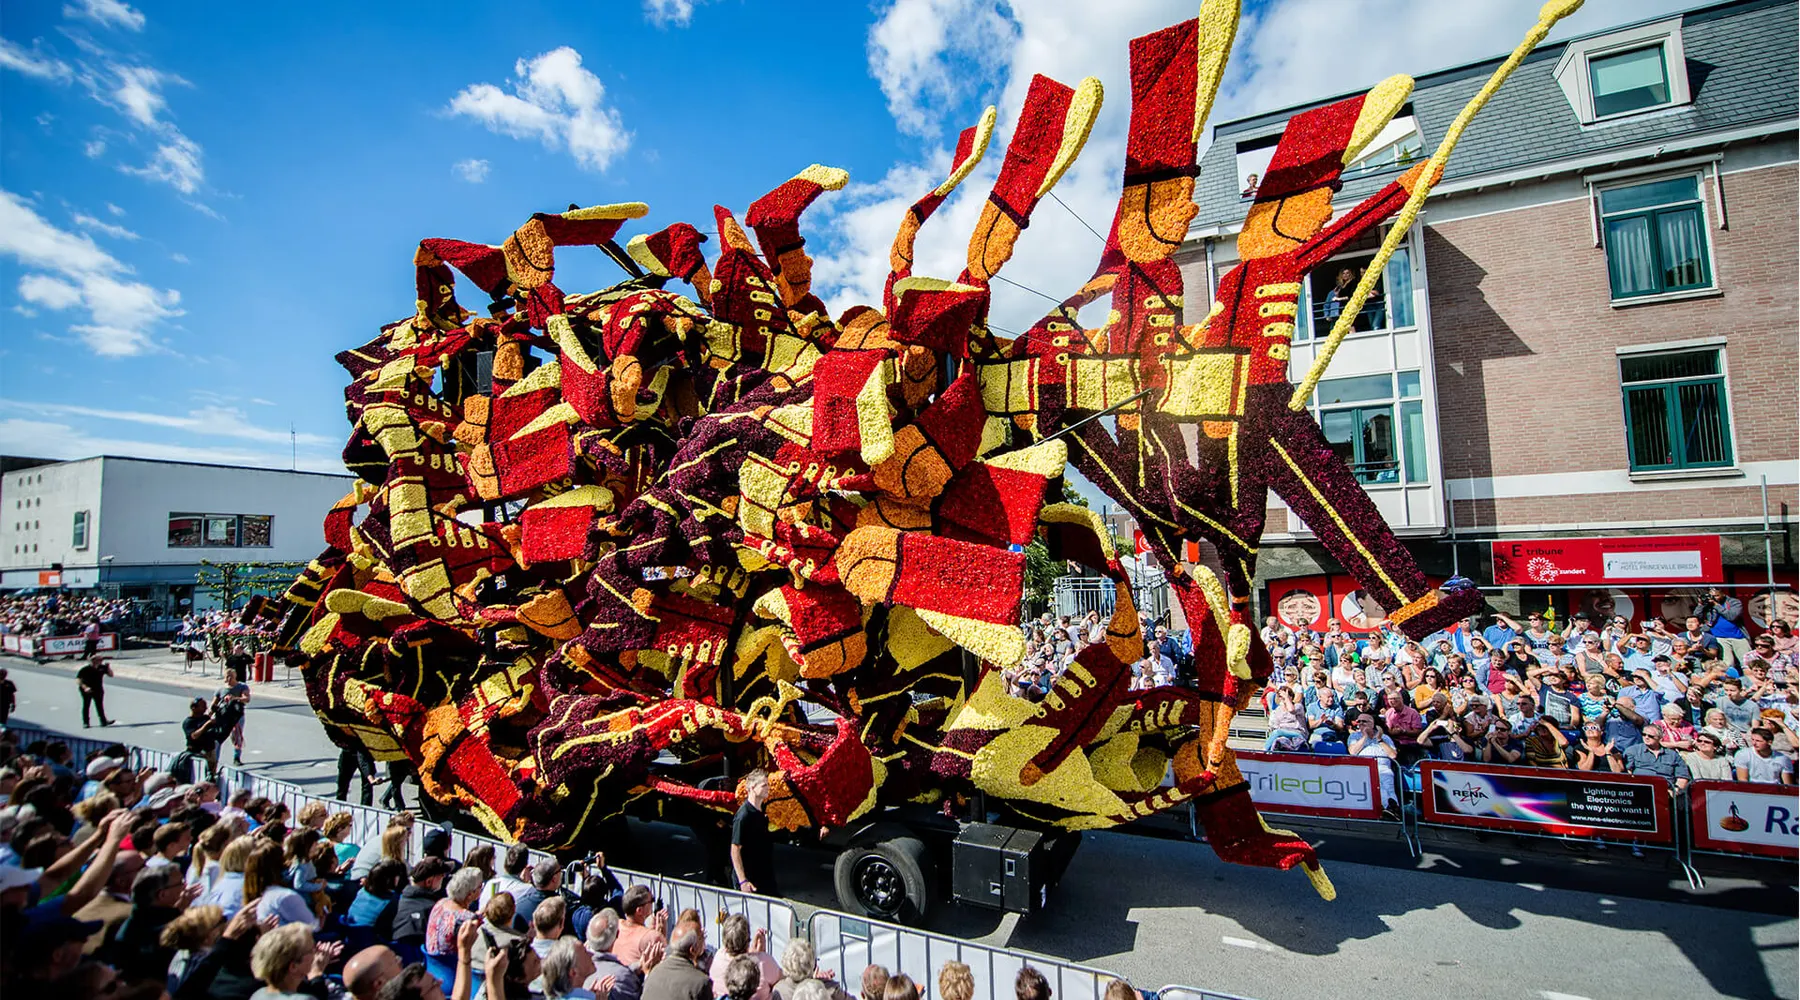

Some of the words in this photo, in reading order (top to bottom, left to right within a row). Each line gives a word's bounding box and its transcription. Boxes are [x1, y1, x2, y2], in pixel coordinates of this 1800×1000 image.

[1512, 544, 1522, 557] E
[1241, 770, 1368, 802] Triledgy
[1453, 790, 1489, 799] RENA
[1583, 787, 1616, 797] Lighting
[1587, 795, 1632, 805] Electronics
[1571, 802, 1584, 810] the
[1586, 805, 1602, 813] way
[1644, 807, 1650, 815] it
